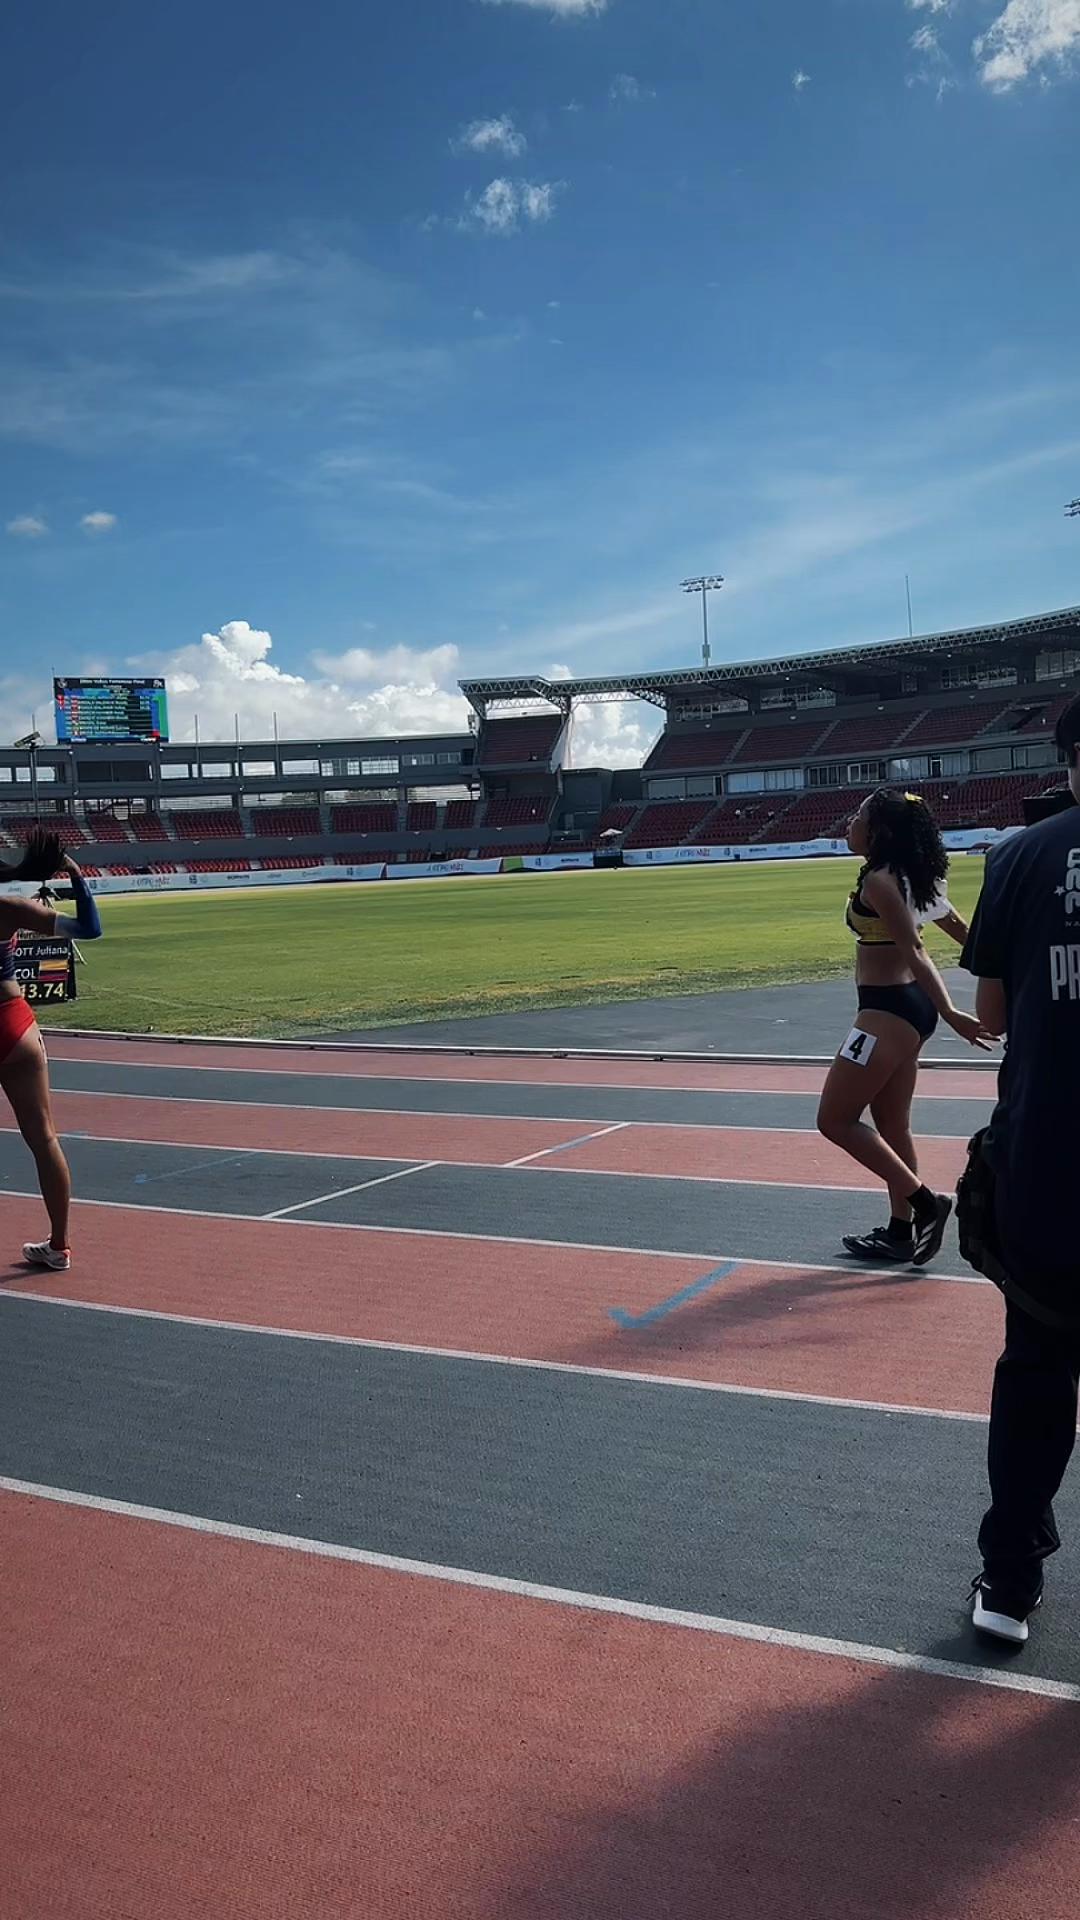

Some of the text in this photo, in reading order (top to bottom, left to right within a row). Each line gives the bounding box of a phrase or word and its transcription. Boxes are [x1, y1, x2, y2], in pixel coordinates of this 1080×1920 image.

[35, 945, 68, 956] Juliana
[14, 968, 36, 980] COL
[19, 982, 64, 999] 13.74
[848, 1033, 867, 1060] 4
